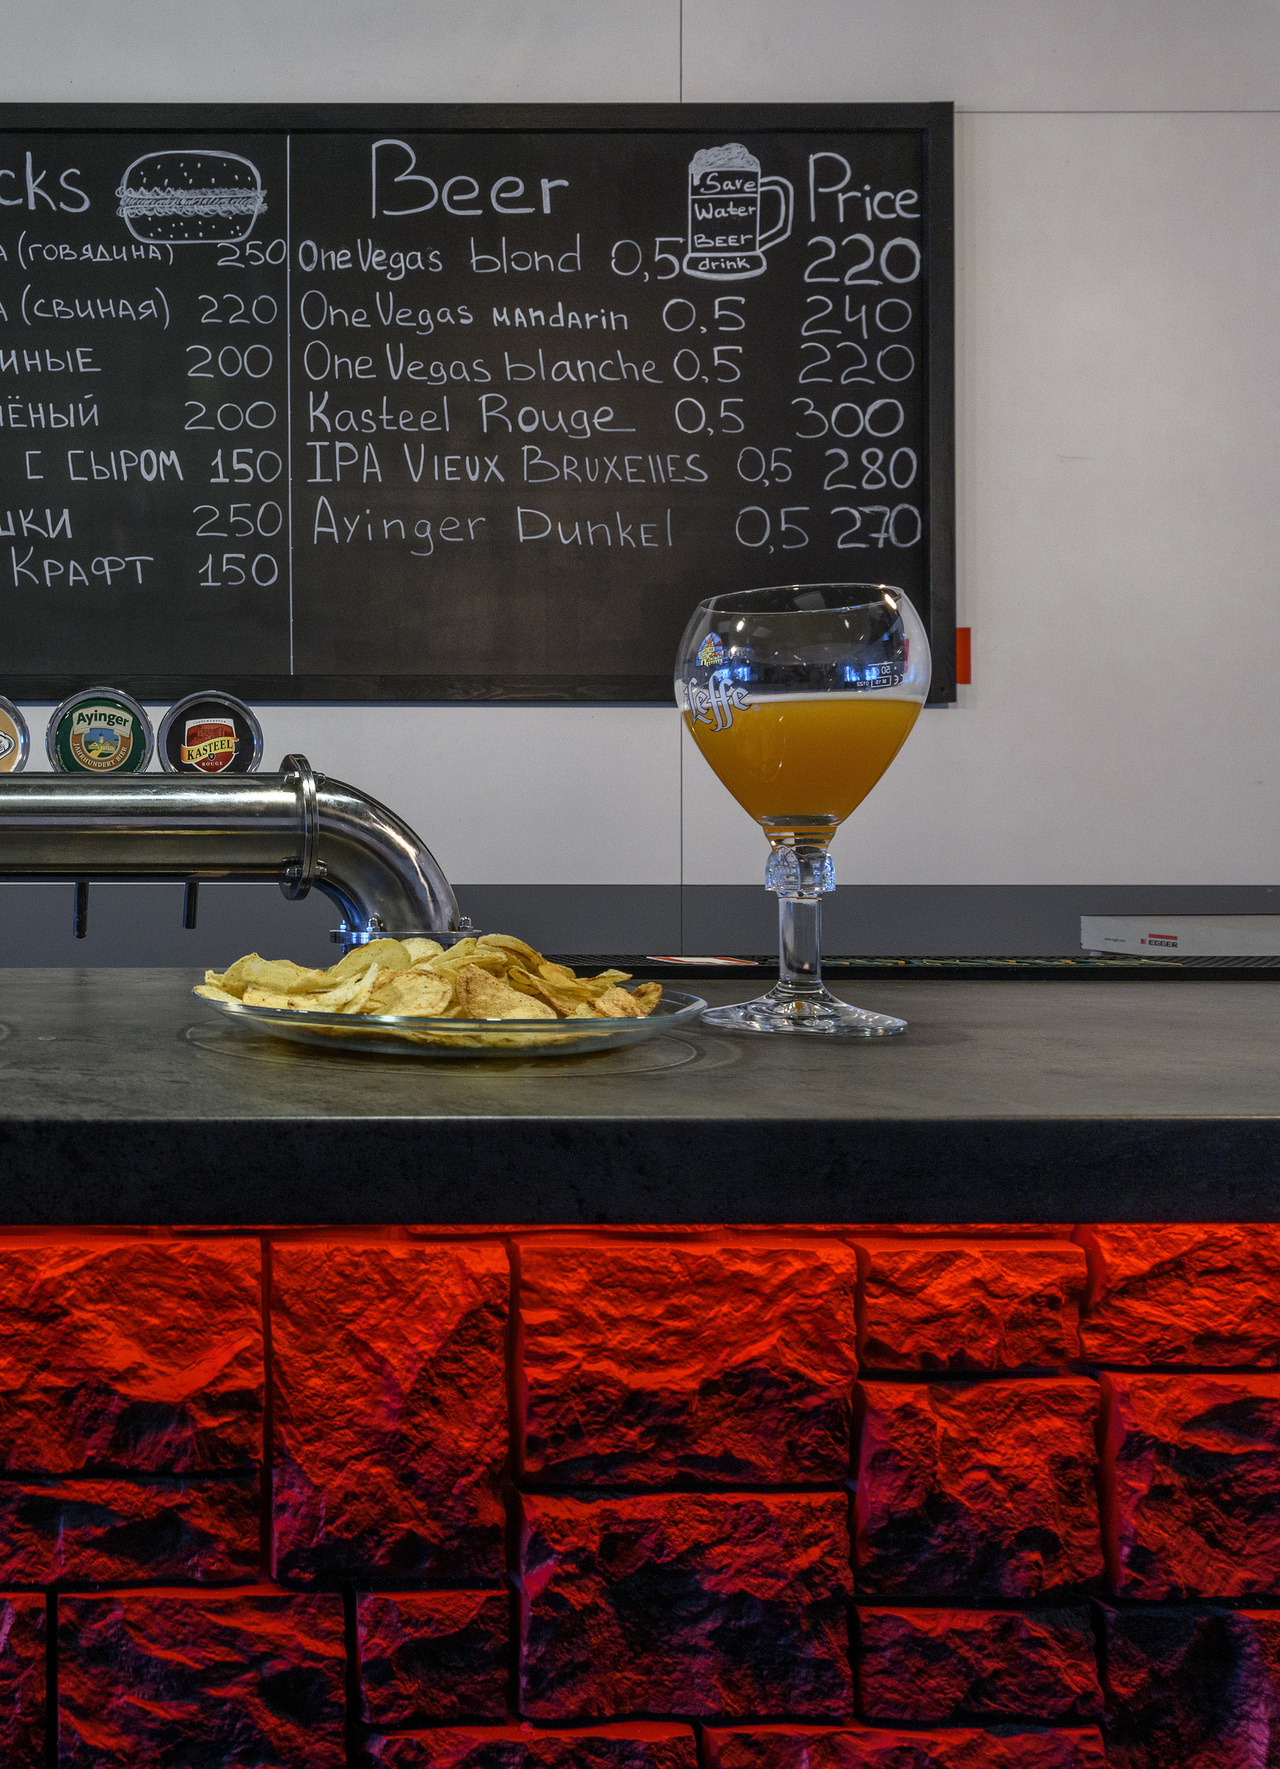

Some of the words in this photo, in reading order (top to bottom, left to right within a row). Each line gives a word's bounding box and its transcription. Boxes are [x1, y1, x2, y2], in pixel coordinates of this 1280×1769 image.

[372, 139, 569, 219] Beer
[700, 172, 757, 194] Save
[809, 152, 920, 222] Price
[694, 202, 757, 220] Water
[217, 239, 286, 267] 250
[471, 233, 581, 273] blond
[611, 237, 686, 282] 0,5
[804, 233, 920, 285] 220
[699, 256, 751, 270] drink
[198, 294, 278, 324] 220
[663, 296, 745, 333] 0,5
[801, 295, 912, 339] 240
[185, 345, 273, 378] 200
[505, 348, 663, 383] blanche
[674, 346, 742, 383] 0,5
[799, 342, 915, 385] 220
[184, 401, 277, 431] 200
[309, 391, 450, 432] Kasteel
[479, 394, 635, 438] Rouge
[675, 397, 744, 436] 0,5
[791, 397, 904, 438] 300
[210, 447, 283, 483] 150
[306, 441, 382, 483] IPA
[737, 446, 792, 487] 0,5
[823, 447, 917, 490] 280
[193, 501, 282, 537] 250
[314, 495, 485, 556] Ayinger
[736, 506, 810, 554] 0,5
[831, 503, 921, 548] 270
[198, 553, 278, 587] 150
[76, 709, 129, 727] Ayinger
[187, 739, 234, 761] KASTEEL
[1148, 939, 1179, 948] EGGER
